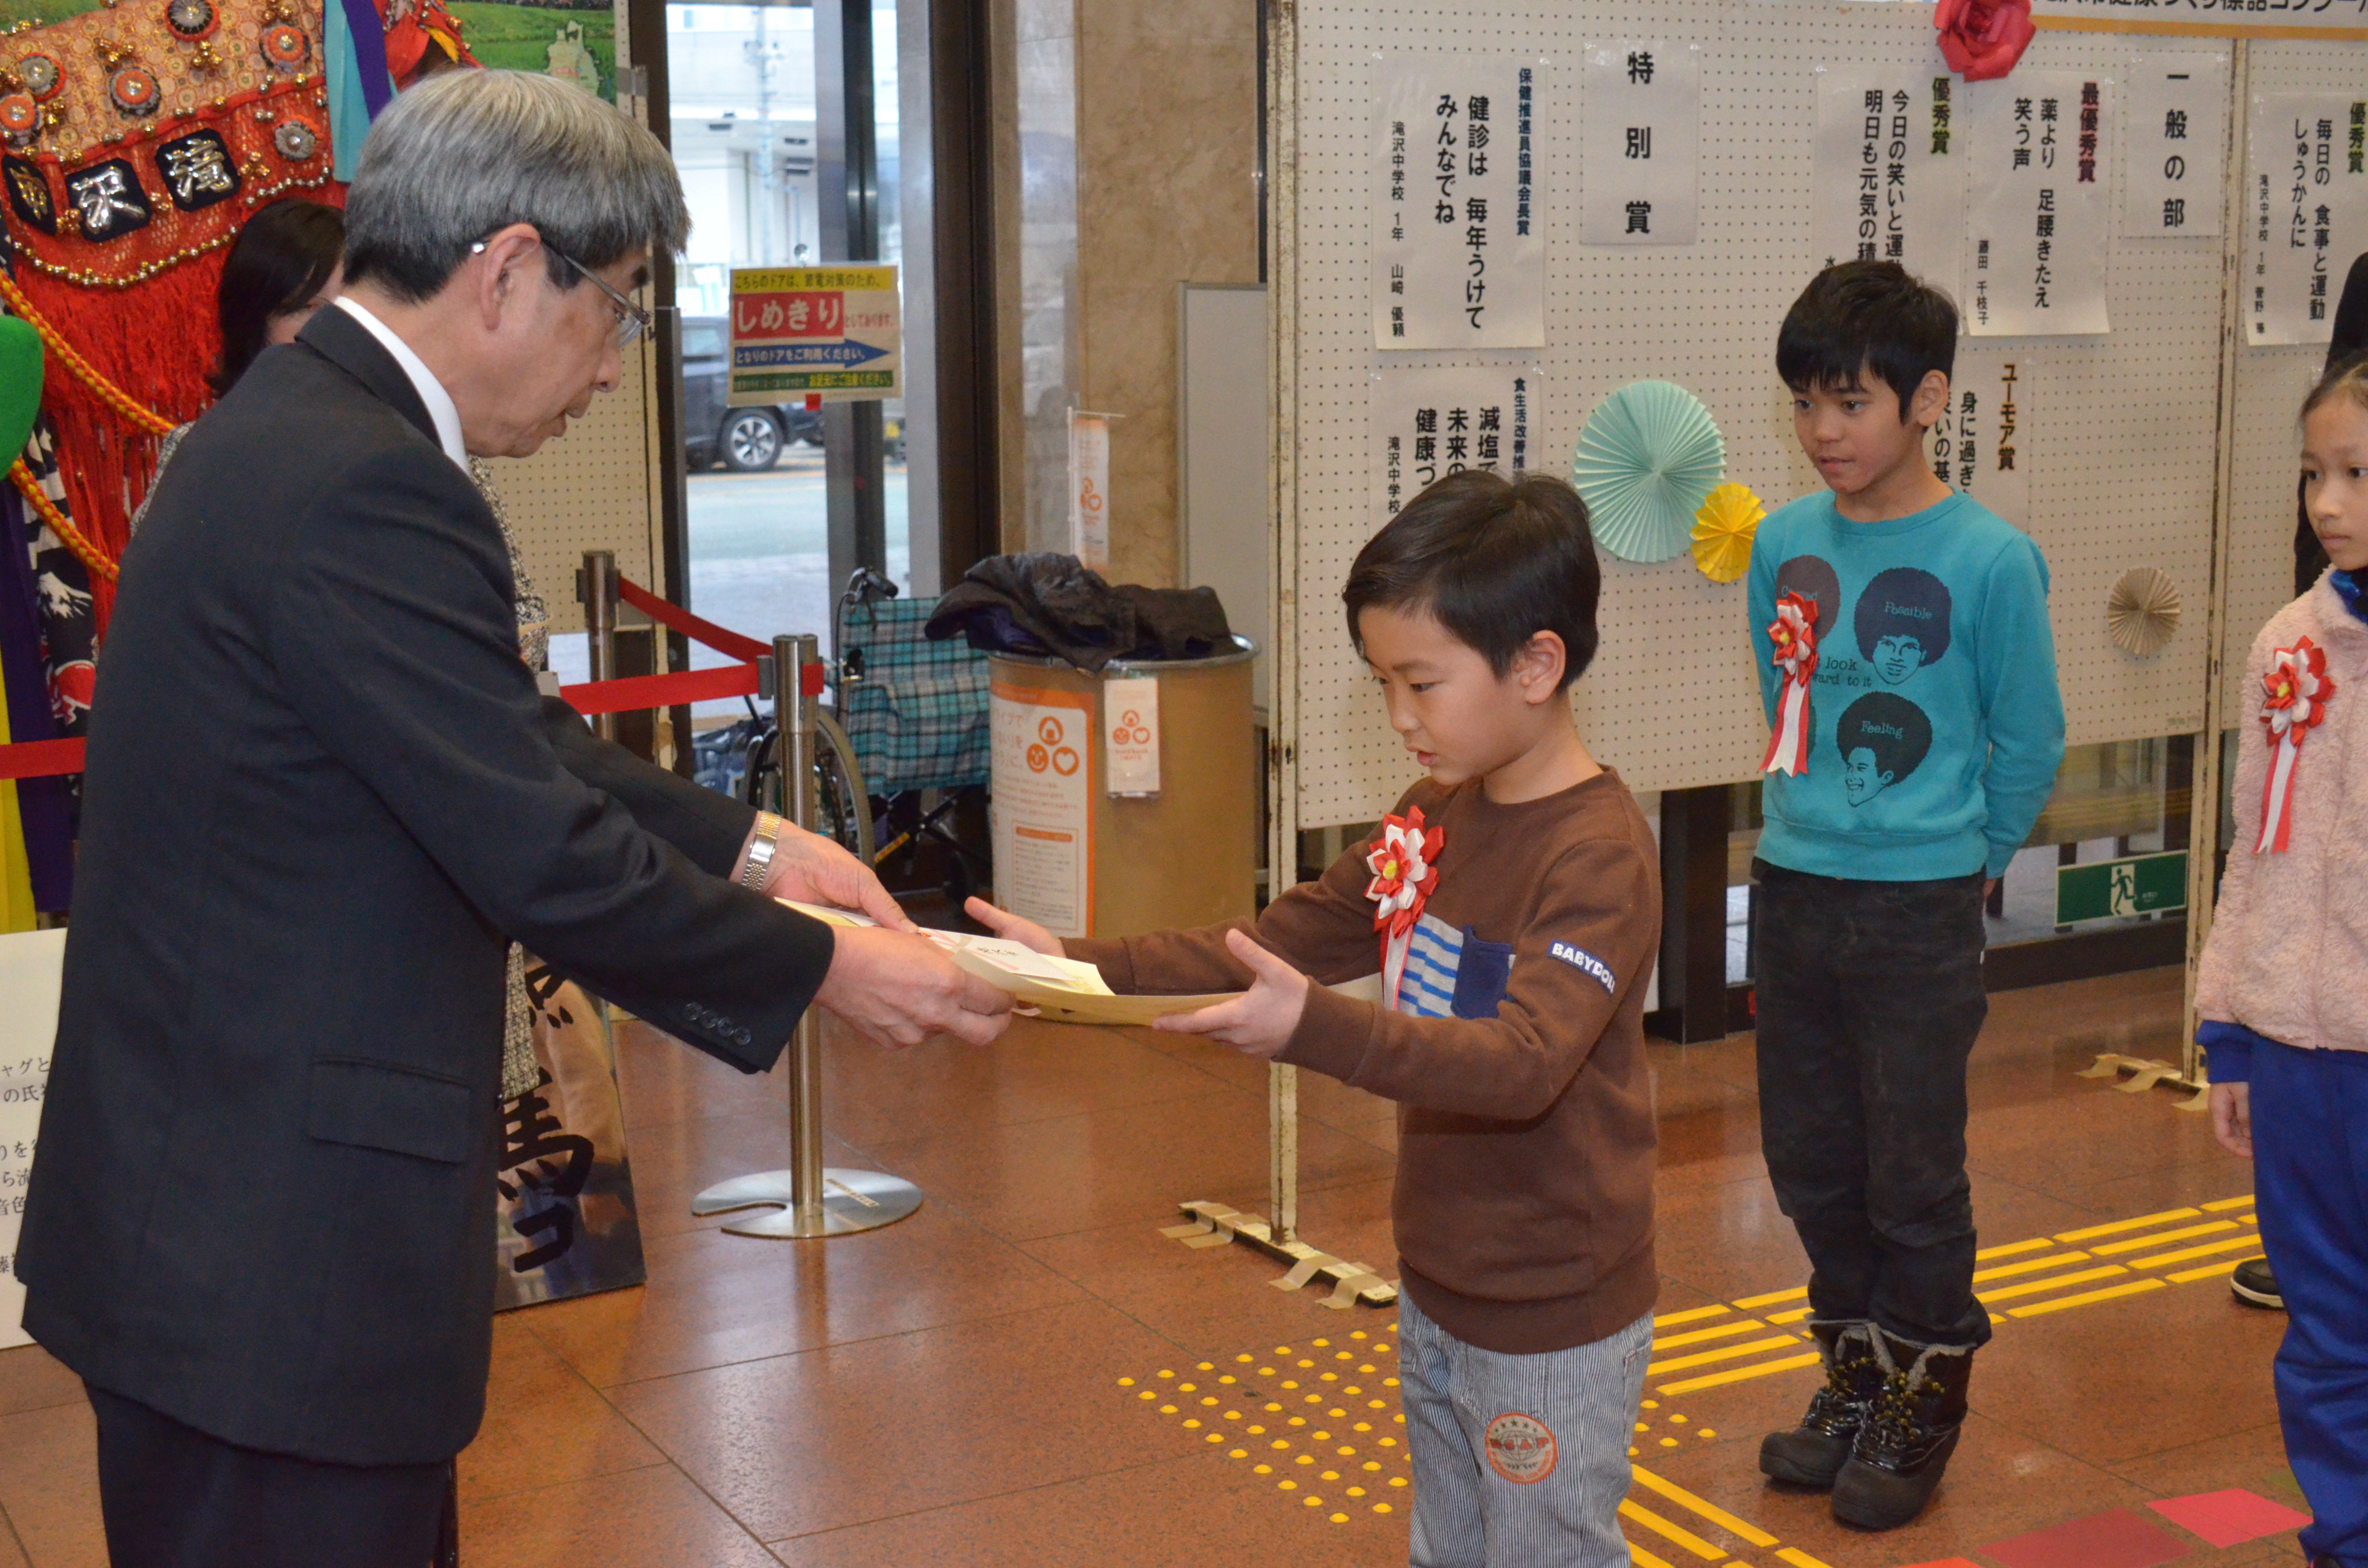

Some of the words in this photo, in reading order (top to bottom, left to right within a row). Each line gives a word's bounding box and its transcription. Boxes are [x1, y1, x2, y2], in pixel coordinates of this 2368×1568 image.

[1435, 94, 1458, 224] みんなでね
[1468, 95, 1490, 176] 健診は
[1517, 68, 1532, 236] 保健推進員協議会長賞
[1625, 51, 1654, 234] 特別賞
[1930, 77, 1950, 155] 優秀賞
[2012, 98, 2032, 171] 笑う声
[2040, 98, 2059, 169] 薬より
[2078, 82, 2099, 183] 最優秀賞
[2163, 74, 2190, 228] 一般の部
[2315, 118, 2332, 185] 毎日の
[2348, 102, 2367, 173] 優秀賞
[1391, 121, 1405, 201] 滝沢中学校
[1885, 89, 1910, 267] 今日の笑いと運
[2290, 119, 2309, 248] しゅうかんに
[1465, 197, 1488, 329] 毎年うけて
[2035, 189, 2055, 308] 足腰きたえ
[2309, 204, 2331, 320] 食事と運動
[738, 298, 839, 333] しめきり
[1513, 377, 1527, 472] 食生活改善推
[1959, 391, 1977, 494] 身に過ぎ
[1998, 364, 2018, 471] ユーモア賞
[1387, 436, 1401, 514] 滝沢中学校
[1885, 601, 1932, 620] Possible
[1825, 656, 1857, 671] look
[1847, 676, 1859, 686] to
[1860, 721, 1904, 739] Feeling
